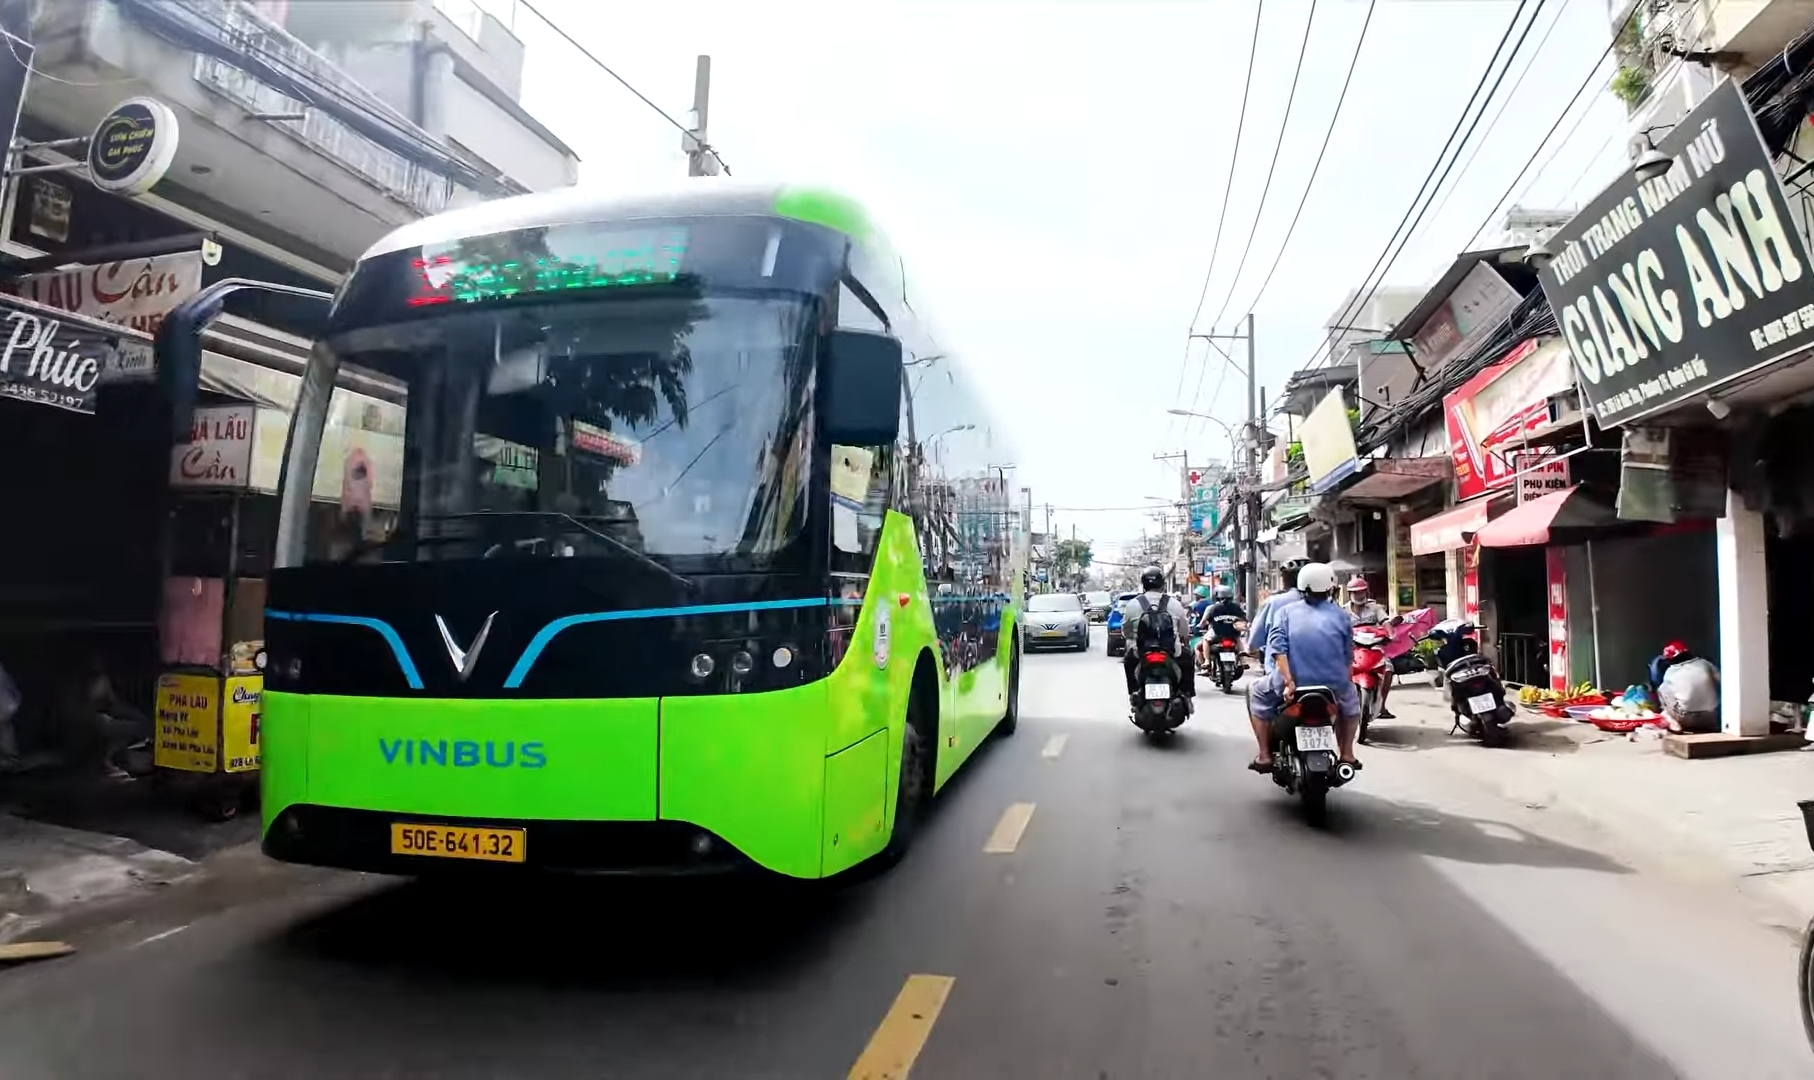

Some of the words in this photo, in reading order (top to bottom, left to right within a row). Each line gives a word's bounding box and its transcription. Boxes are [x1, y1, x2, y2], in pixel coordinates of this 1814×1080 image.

[1581, 196, 1643, 260] TRANG
[1637, 154, 1693, 218] NAM
[1562, 248, 1683, 384] GIANG
[1675, 168, 1803, 328] ANH
[1547, 461, 1564, 473] PIN
[379, 738, 547, 768] VINBUS
[402, 829, 513, 856] 50E-641.32
